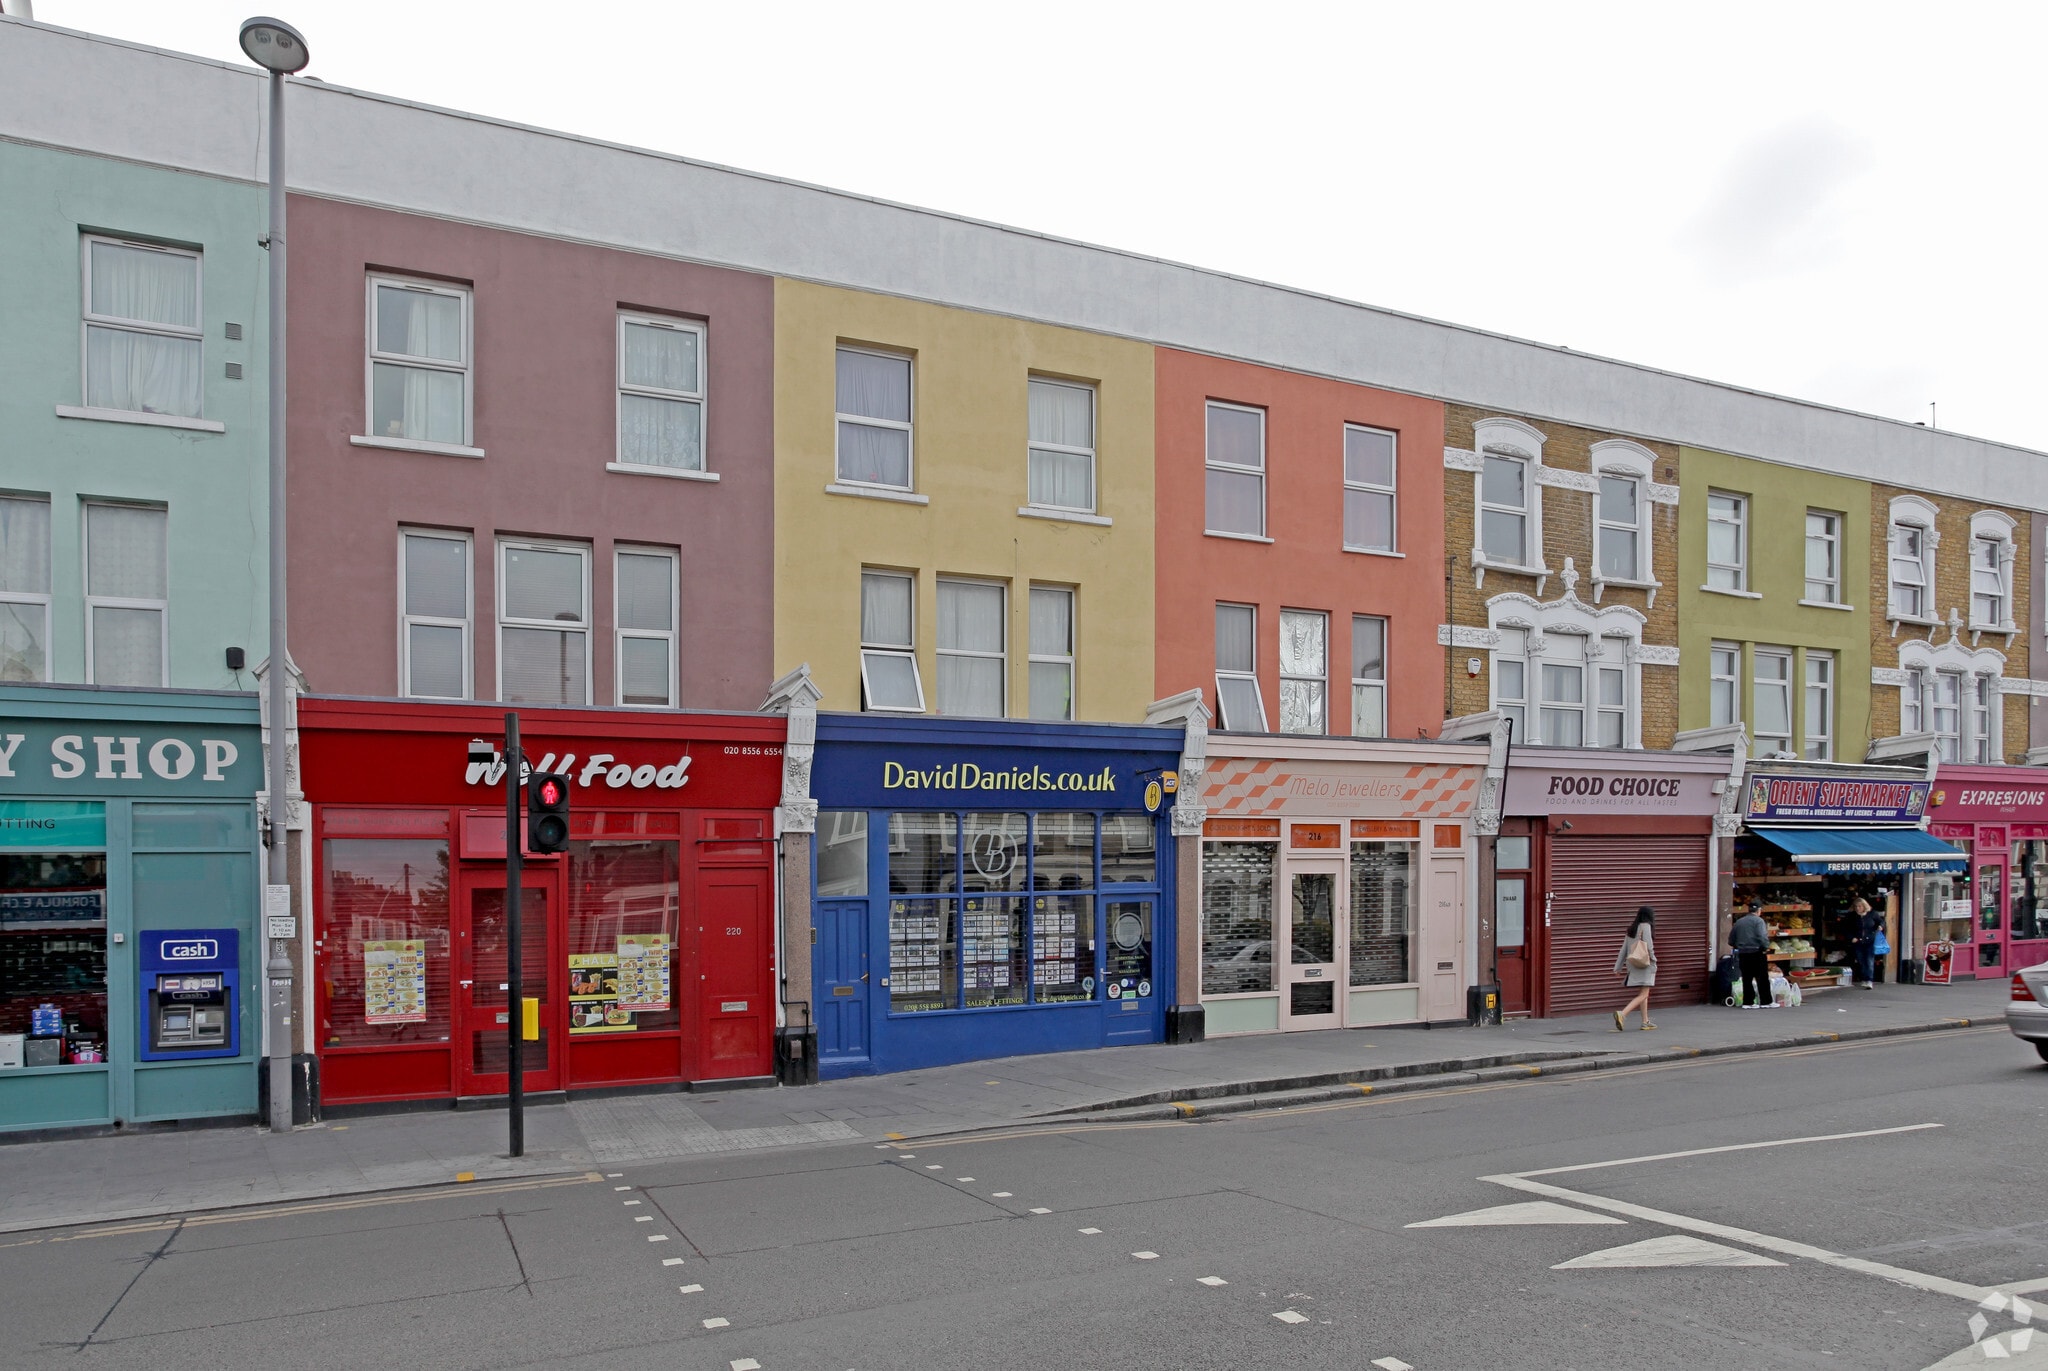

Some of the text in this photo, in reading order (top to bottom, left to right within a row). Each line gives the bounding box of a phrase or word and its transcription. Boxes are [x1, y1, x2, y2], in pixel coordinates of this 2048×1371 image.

[51, 735, 238, 781] SHOP
[742, 747, 761, 755] 8556
[578, 754, 692, 789] Food
[1290, 777, 1402, 798] Melo Jewellers
[1548, 776, 1681, 797] FOOD CHOICE
[1769, 780, 1912, 808] ORIENT SUPERMARKET
[0, 818, 55, 829] TTING
[1827, 863, 1850, 871] FRESH
[1878, 862, 1892, 870] VEG
[1911, 861, 1939, 869] LICENCE
[172, 943, 208, 957] cash
[994, 997, 1024, 1005] LETTINGS
